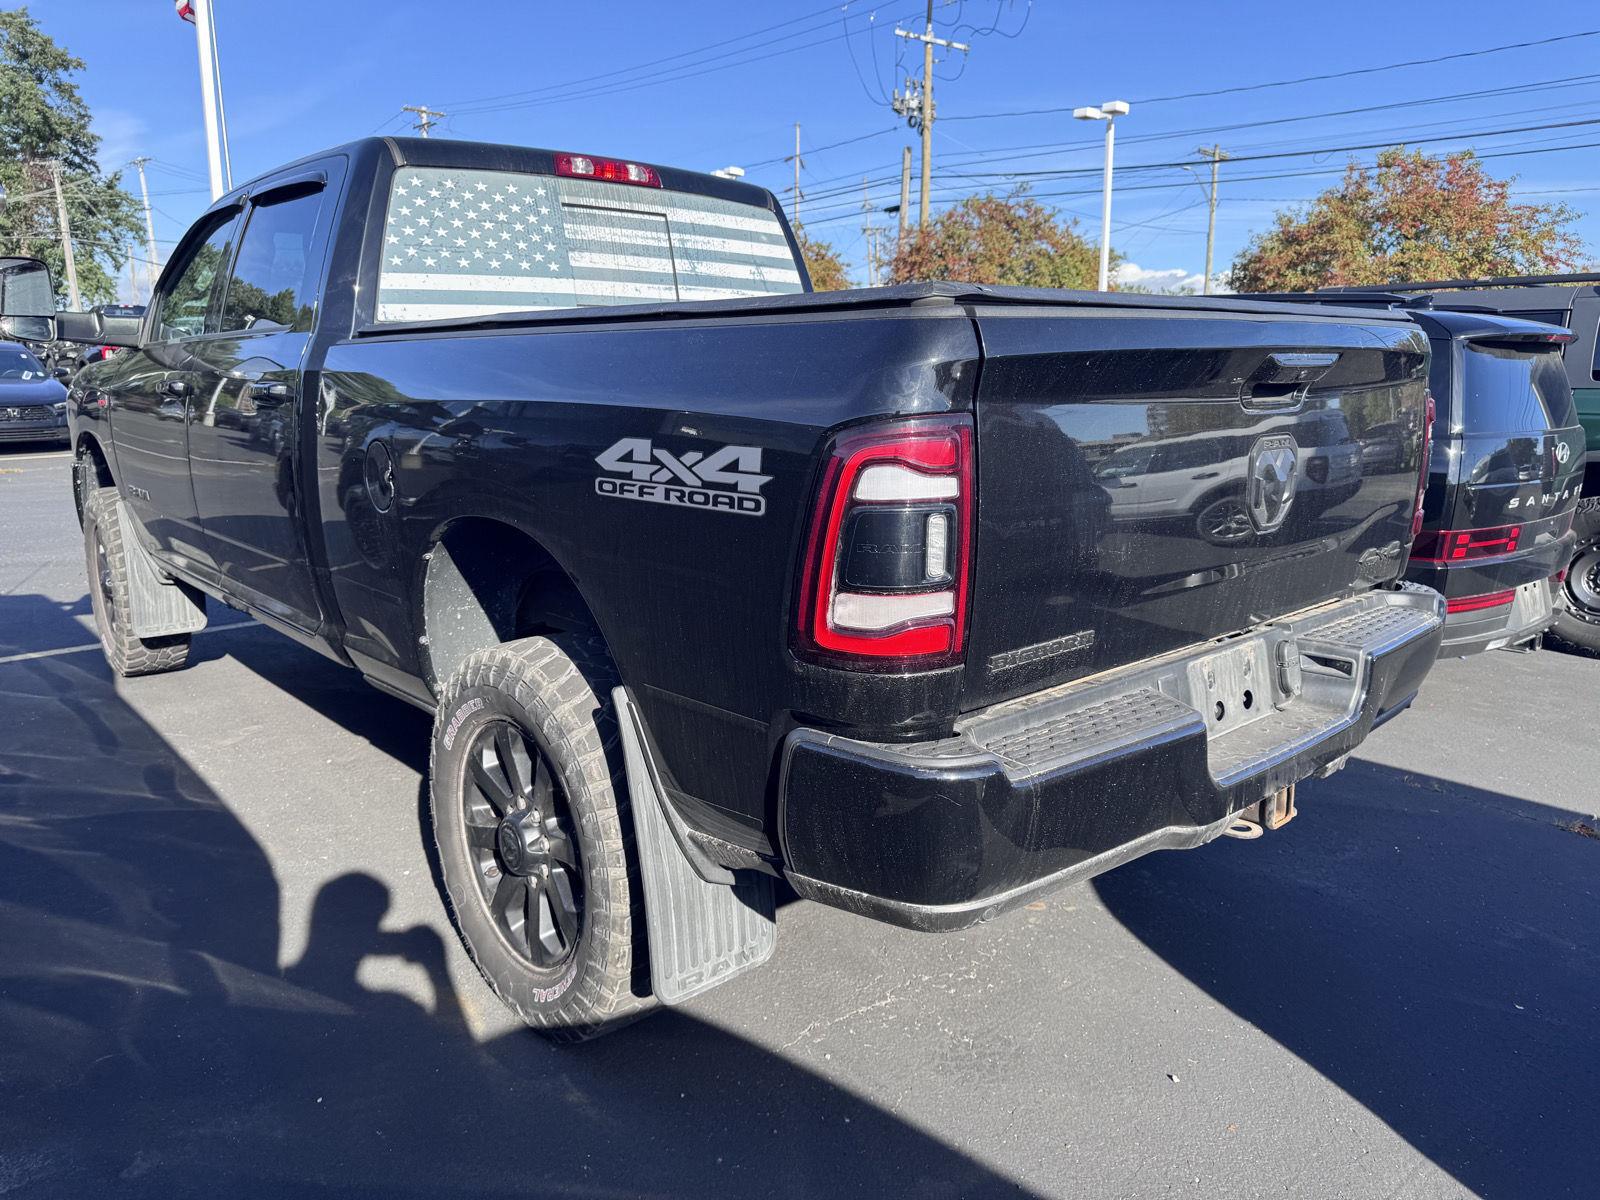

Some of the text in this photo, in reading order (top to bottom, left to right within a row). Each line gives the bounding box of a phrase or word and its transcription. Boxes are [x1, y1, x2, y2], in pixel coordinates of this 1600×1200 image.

[1264, 439, 1291, 449] RAM
[597, 479, 763, 514] OFF ROAD
[1508, 489, 1569, 509] SANTA
[856, 543, 922, 554] RAM
[443, 697, 485, 751] GRABBER
[677, 942, 761, 991] RAM
